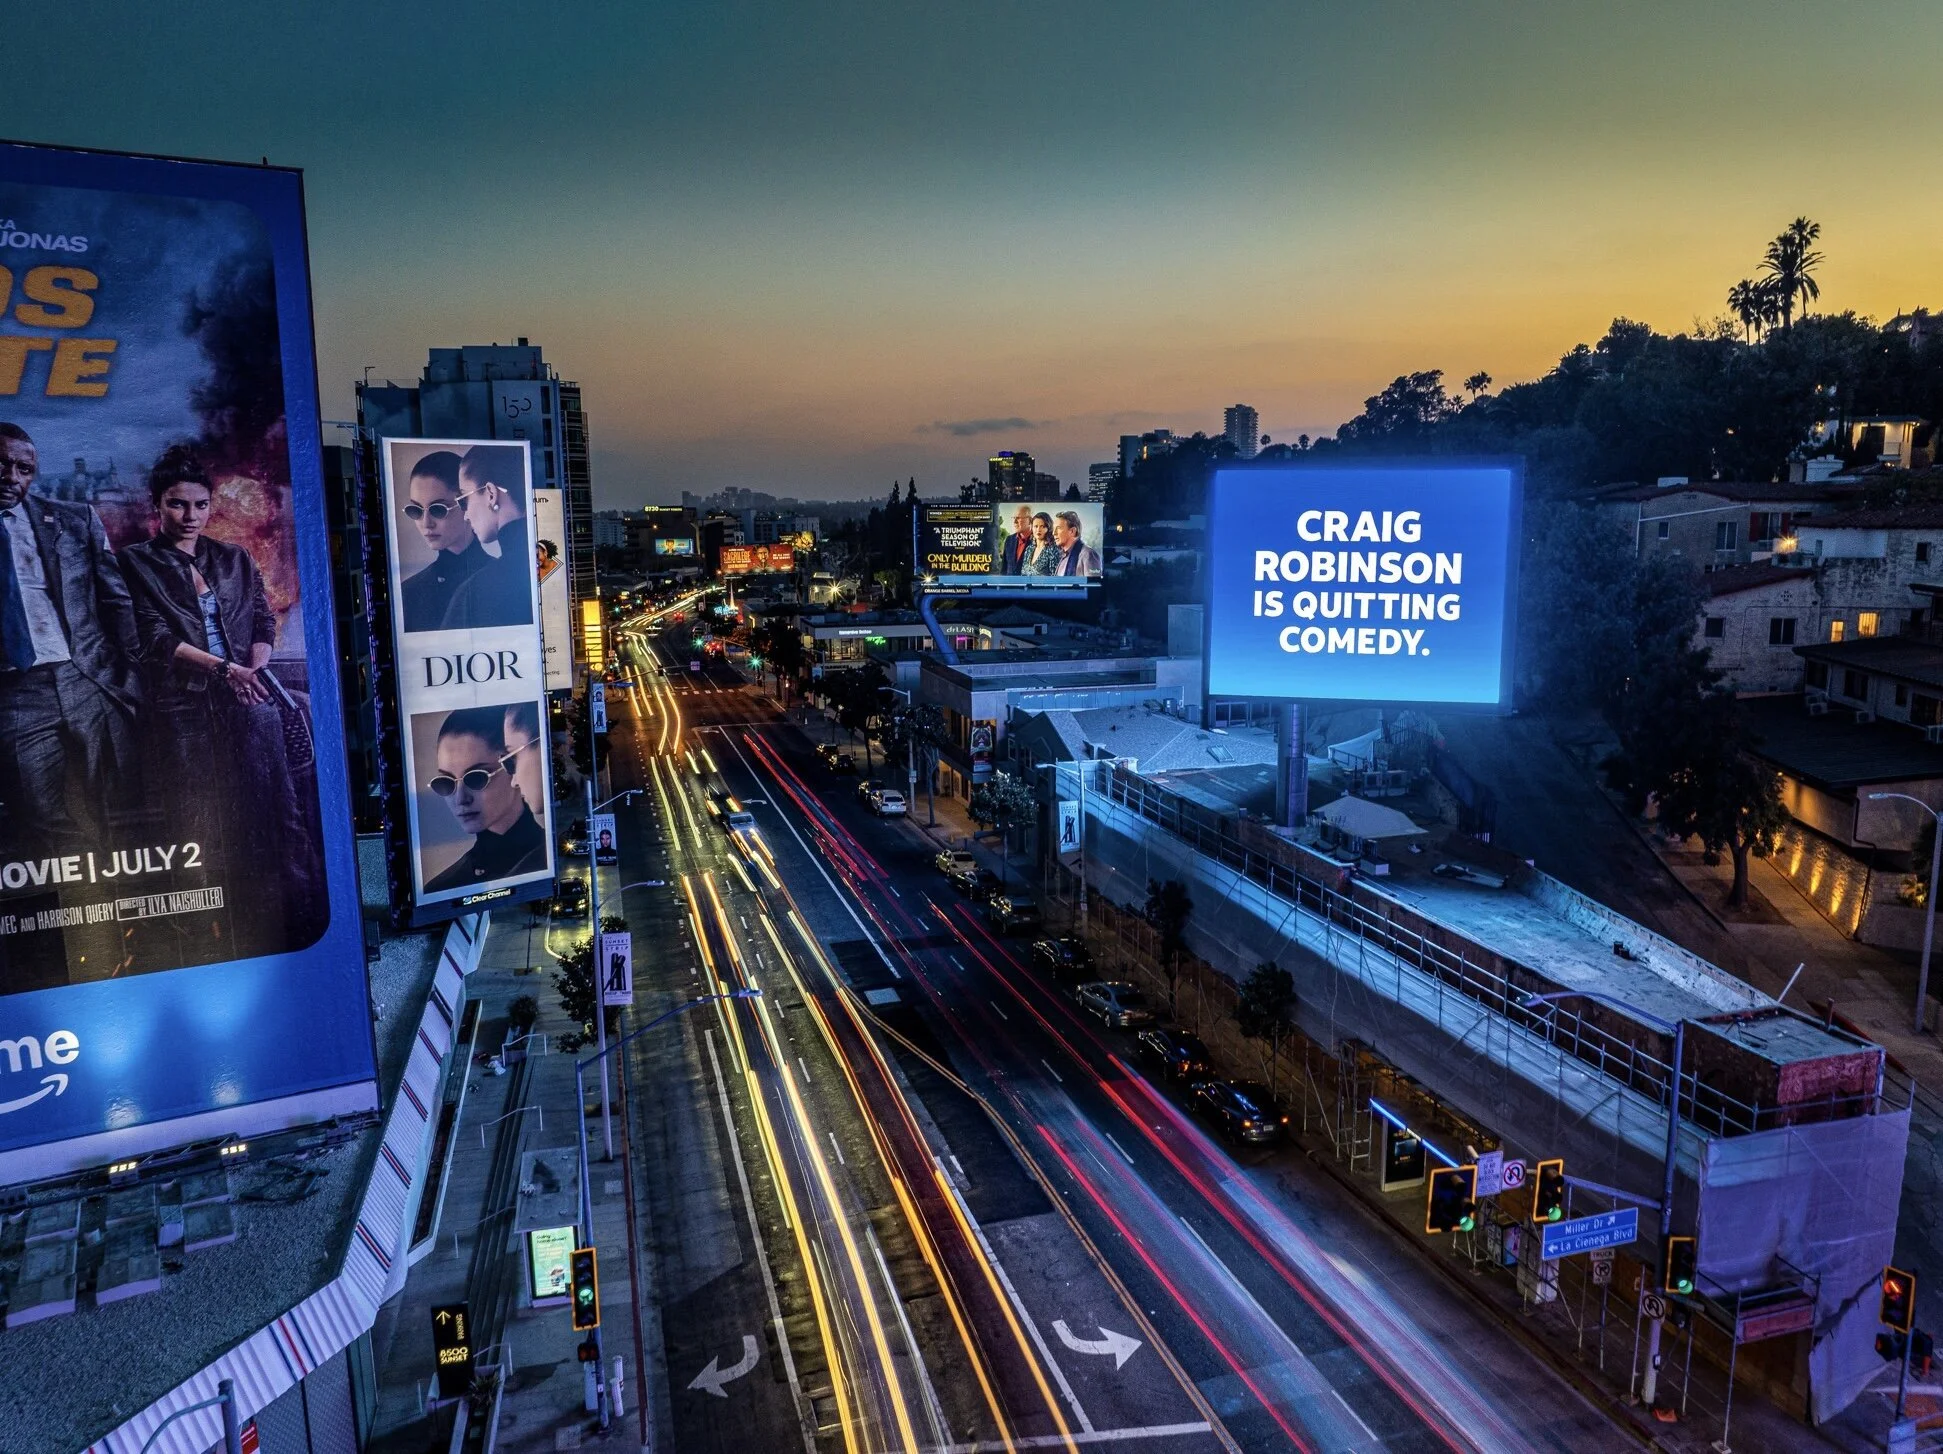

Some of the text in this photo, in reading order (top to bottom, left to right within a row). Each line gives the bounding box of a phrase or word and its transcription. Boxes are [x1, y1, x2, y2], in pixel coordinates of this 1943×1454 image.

[0, 230, 88, 253] JONAS
[0, 265, 99, 328] S
[0, 336, 117, 398] TE
[1296, 510, 1421, 543] CRAIG
[928, 554, 992, 562] ONLY MURDERS
[952, 563, 989, 571] BUILDING
[1254, 550, 1462, 584] ROBINSON
[1253, 590, 1461, 621] IS QUITTING
[1279, 626, 1431, 656] COMEDY.
[421, 650, 524, 687] DIOR
[102, 844, 177, 877] JULY
[182, 842, 202, 868] 2
[120, 899, 146, 910] DIRECTED
[148, 888, 221, 915] ILYA NAISHULLER
[472, 889, 511, 903] Clear Channel
[20, 916, 36, 932] AND
[37, 906, 83, 930] HARRISON
[85, 902, 114, 924] QUERY
[138, 907, 147, 916] BY
[0, 1030, 80, 1074] me
[1561, 1228, 1633, 1252] La Cienega Blvd
[1565, 1218, 1603, 1235] Miller Dr
[455, 1313, 465, 1341] PARKING
[440, 1346, 468, 1357] 8500
[440, 1354, 468, 1365] SUNSET
